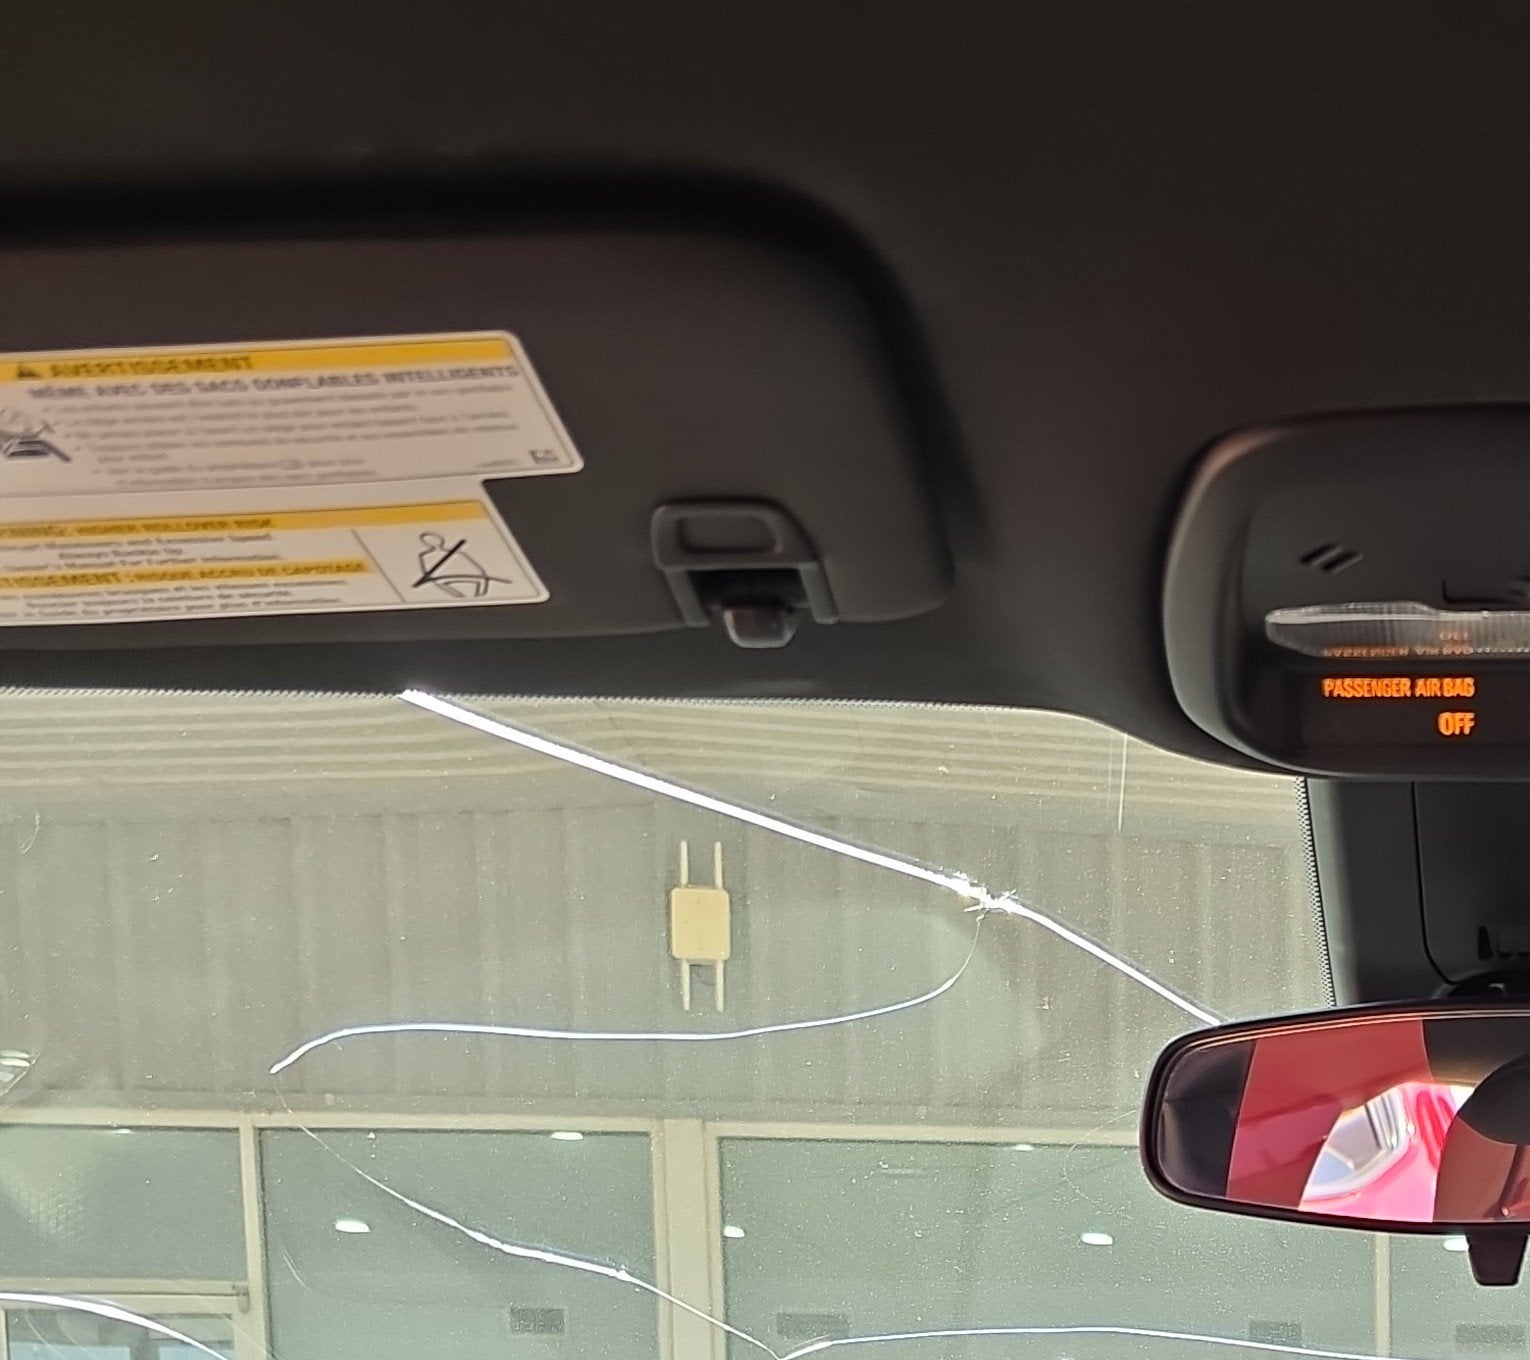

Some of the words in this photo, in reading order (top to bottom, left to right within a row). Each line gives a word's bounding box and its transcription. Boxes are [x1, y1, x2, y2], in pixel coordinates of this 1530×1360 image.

[1322, 678, 1412, 697] PASSENGER
[1415, 678, 1441, 697] AIR
[1442, 678, 1476, 697] BAG
[1438, 712, 1476, 735] OFF
